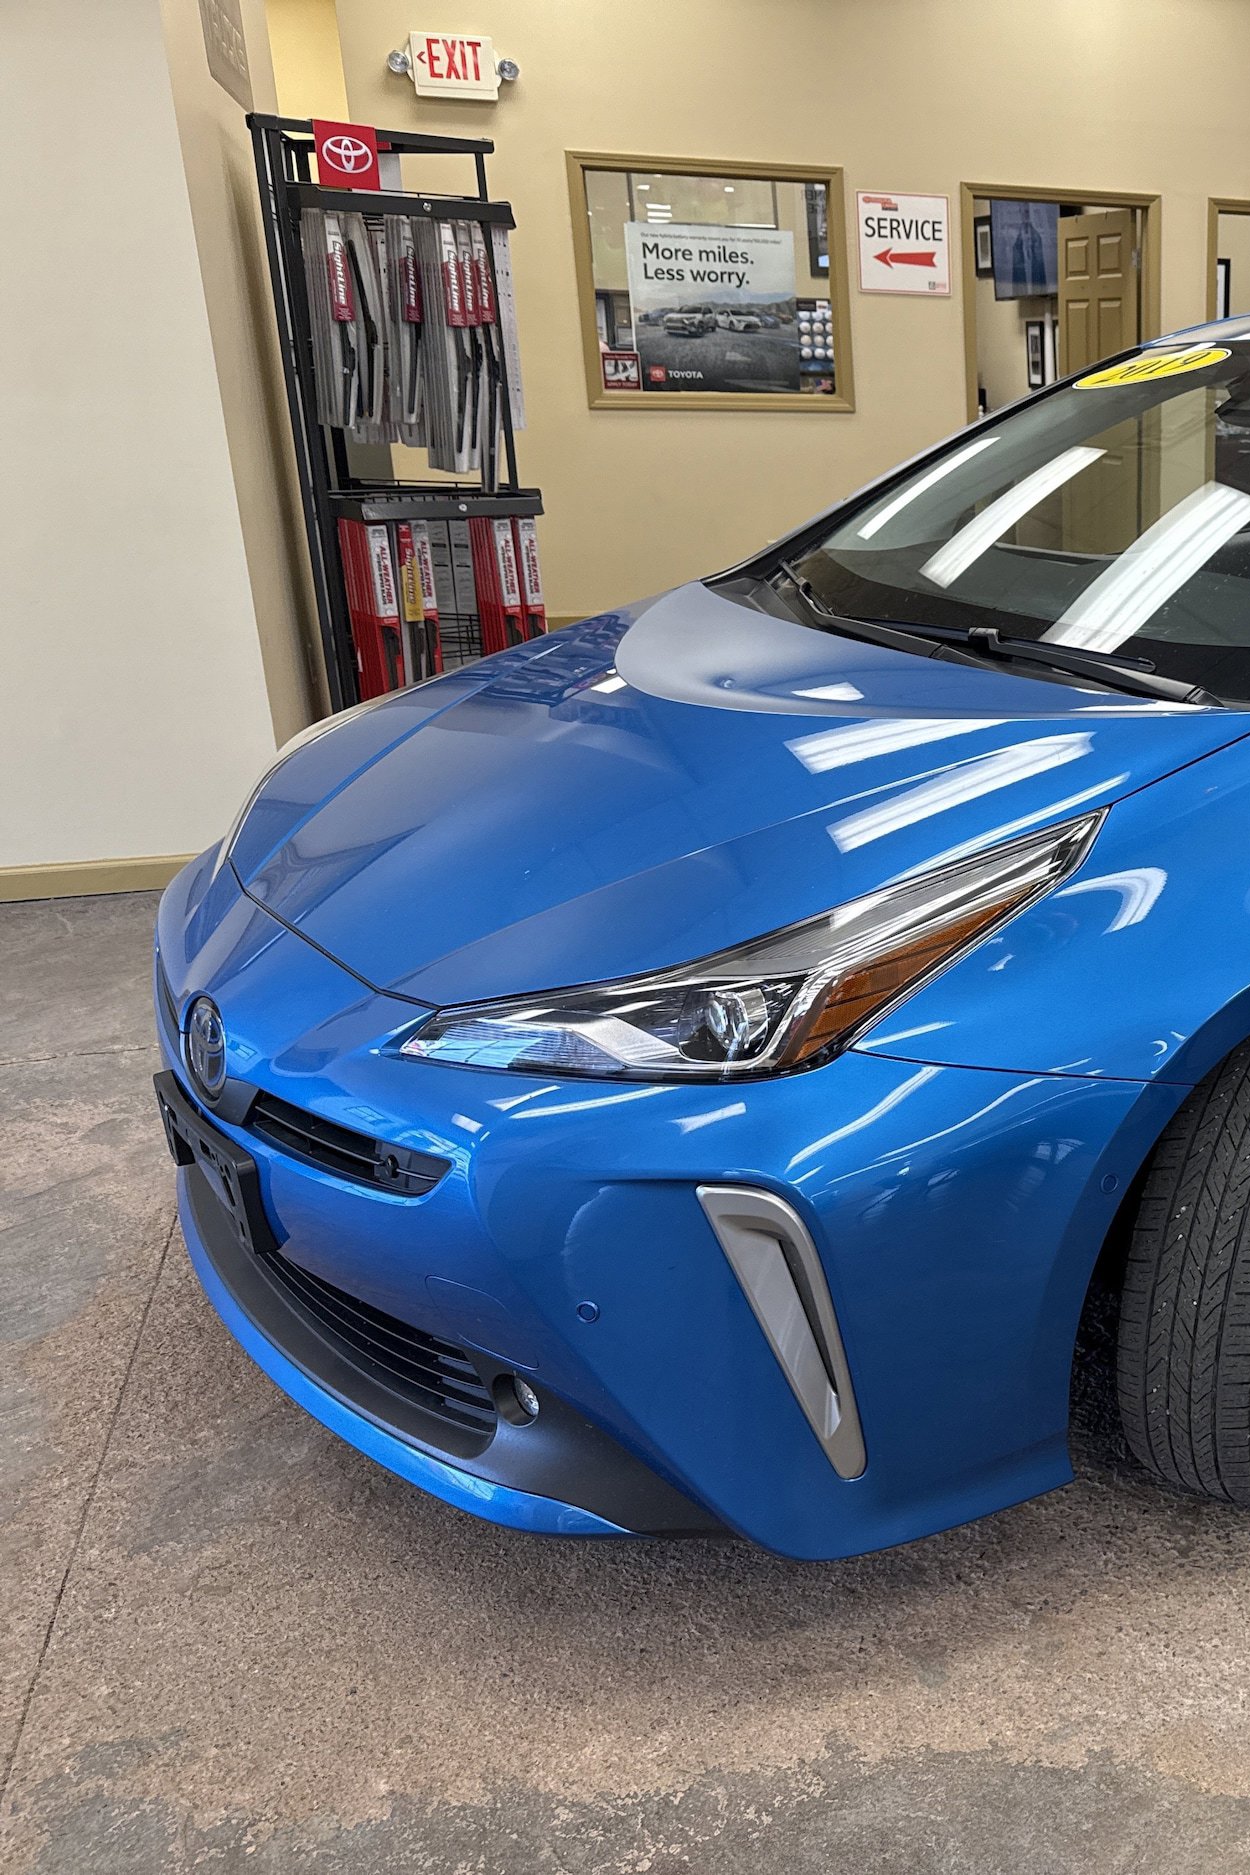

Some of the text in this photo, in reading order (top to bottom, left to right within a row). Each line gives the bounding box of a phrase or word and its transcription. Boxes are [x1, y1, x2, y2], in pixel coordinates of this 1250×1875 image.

[425, 38, 482, 81] EXIT
[642, 242, 754, 265] More miles.
[864, 216, 943, 241] SERVICE
[333, 241, 346, 305] SightLine
[406, 246, 416, 307] SightLine
[447, 250, 460, 312] SightLine
[463, 251, 473, 312] SightLine
[478, 249, 489, 308] SightLine
[643, 263, 750, 288] Less worry.
[668, 370, 703, 379] TOYOTA
[1091, 351, 1212, 385] 2019
[380, 543, 393, 604] ALL-WEATHER
[420, 540, 432, 597] ALL-WEATHER
[504, 538, 516, 594] ALL-WEATHER
[528, 538, 540, 593] ALL-WEATHER
